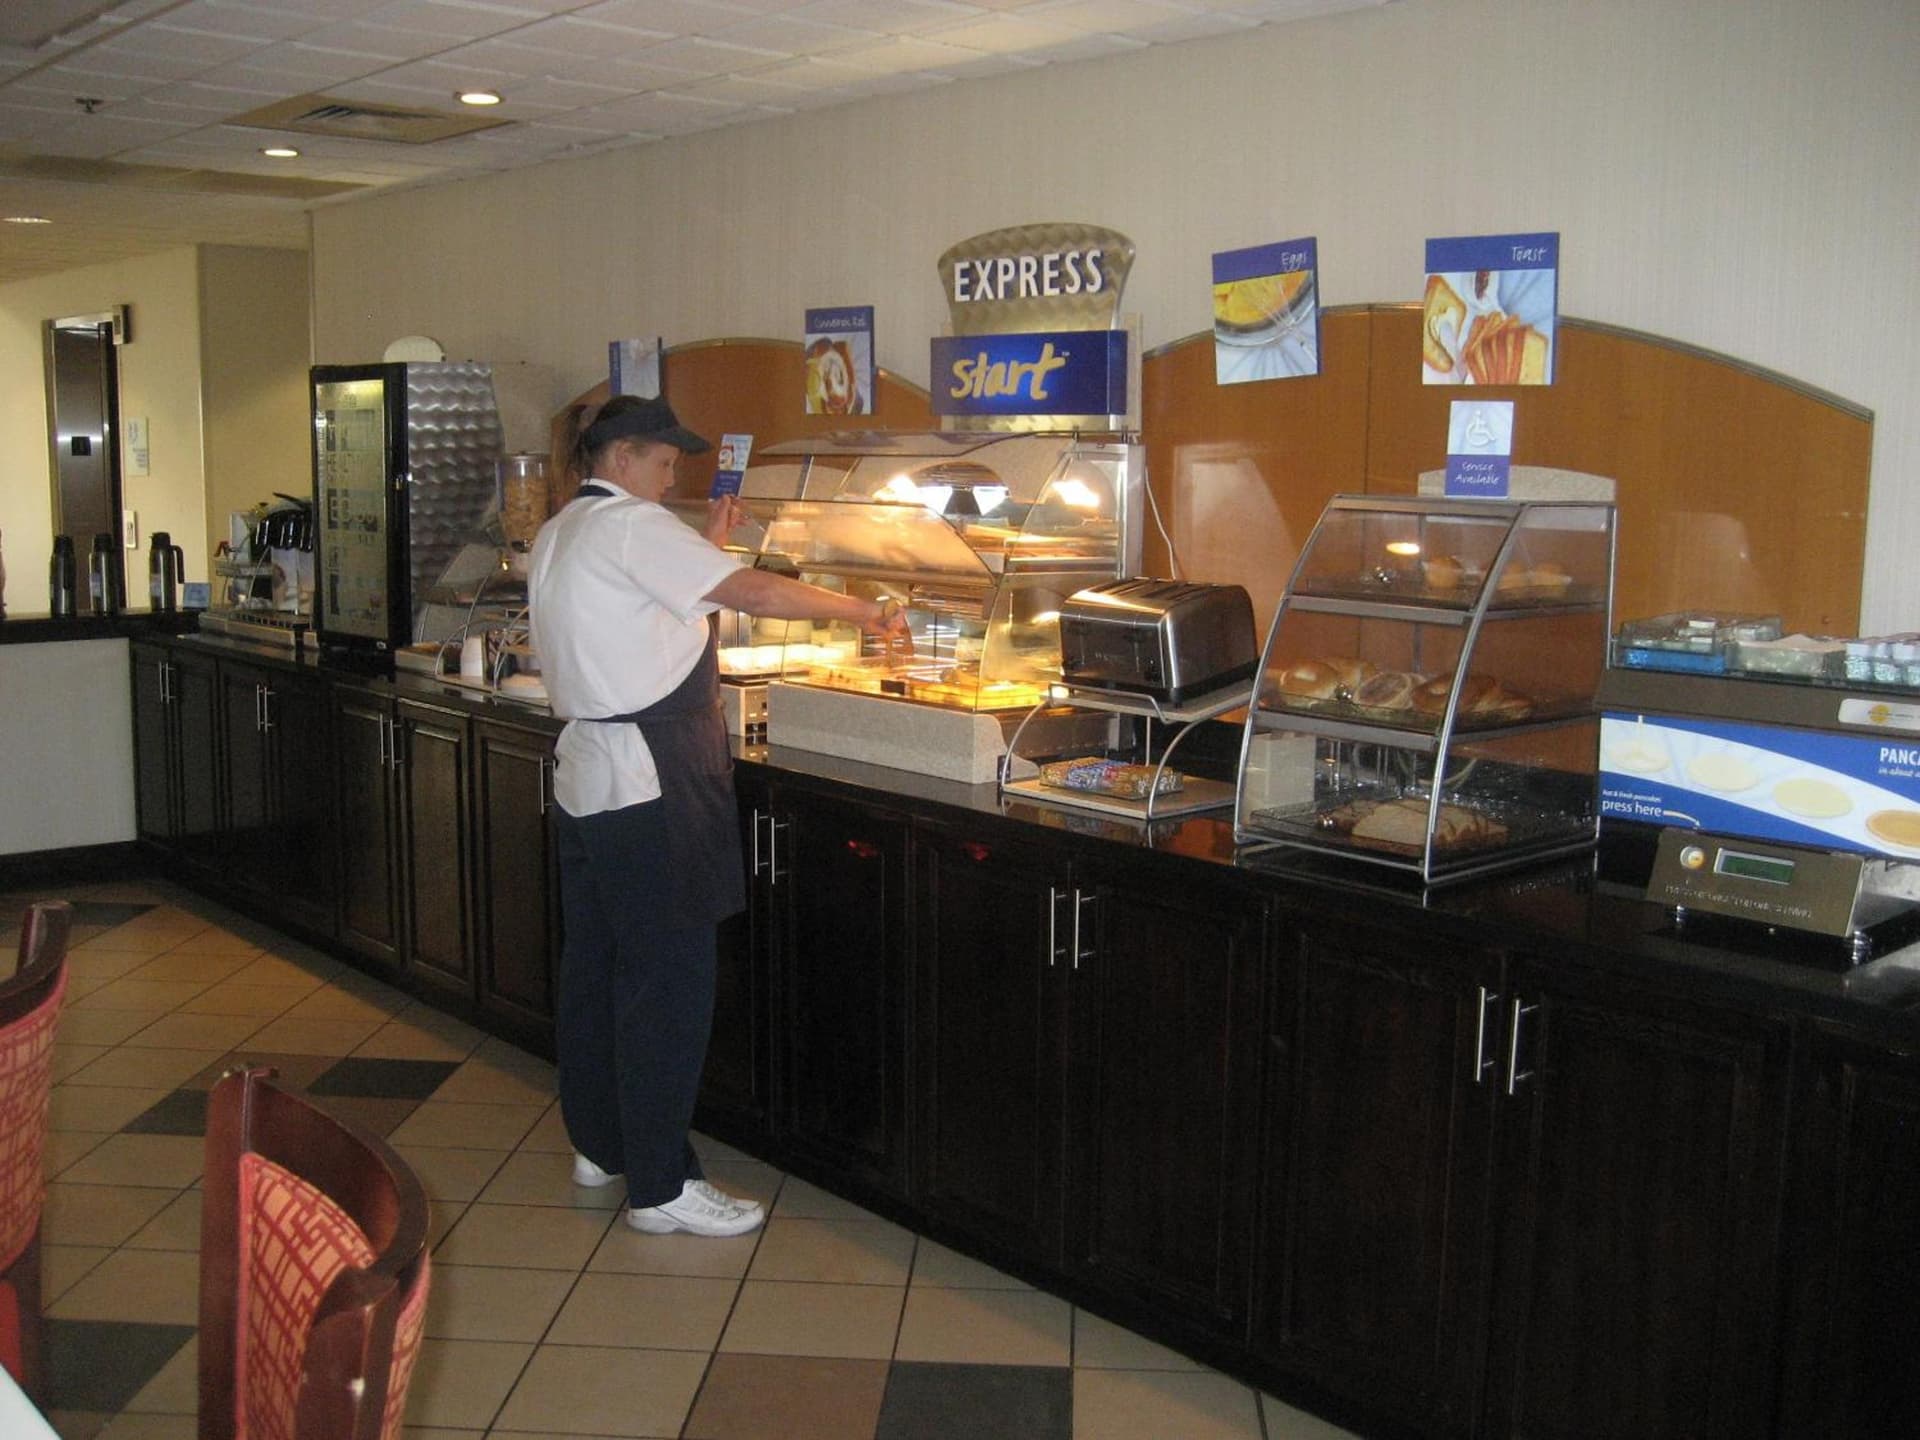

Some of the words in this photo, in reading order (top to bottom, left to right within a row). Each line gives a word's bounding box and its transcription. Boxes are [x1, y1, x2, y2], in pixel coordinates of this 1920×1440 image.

[1511, 246, 1547, 262] Toast
[954, 249, 1103, 302] EXPRESS
[1602, 800, 1633, 813] press
[1635, 802, 1662, 817] here
